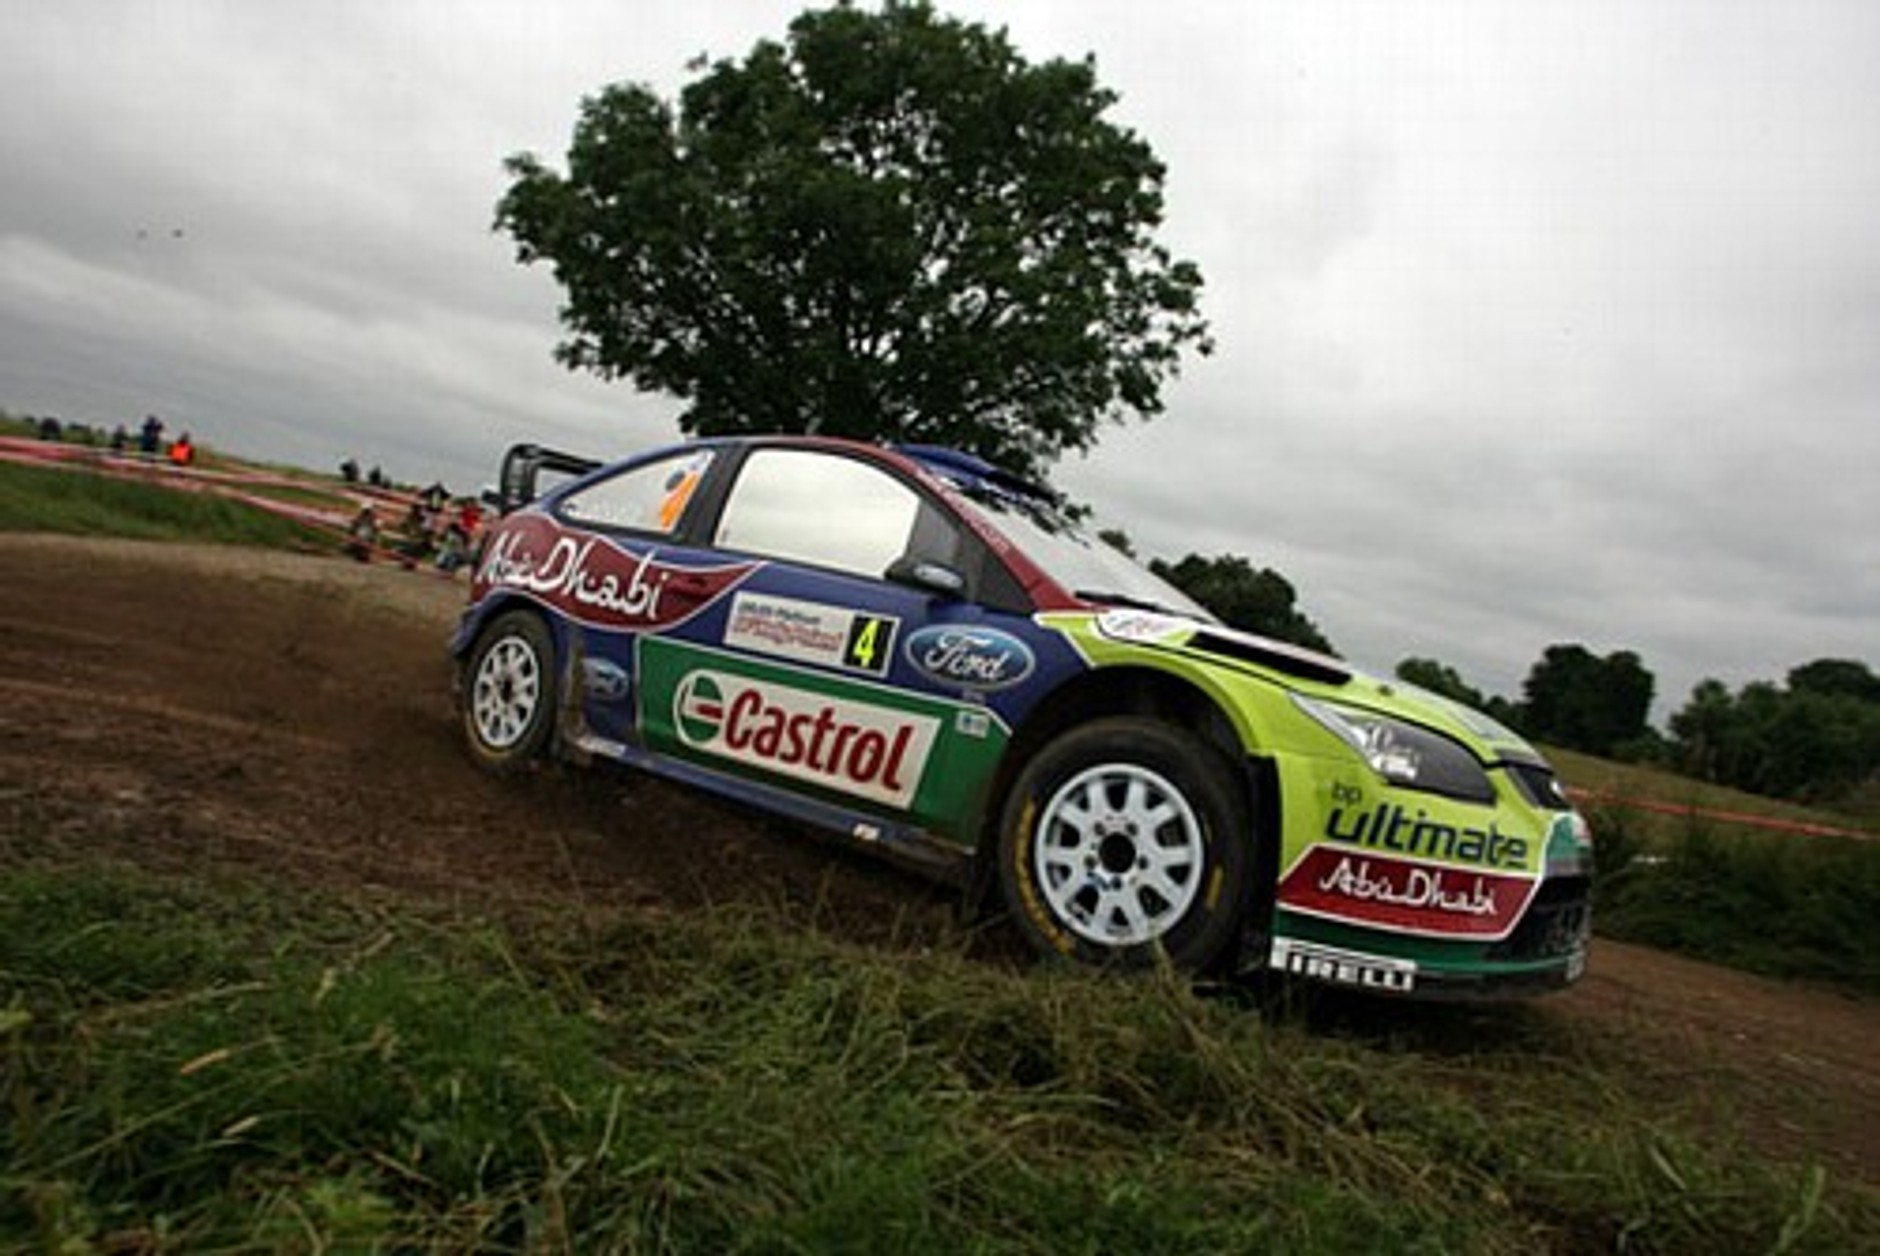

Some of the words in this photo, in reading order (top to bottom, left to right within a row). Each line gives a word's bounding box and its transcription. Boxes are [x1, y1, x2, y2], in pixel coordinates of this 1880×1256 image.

[853, 617, 881, 668] 4
[924, 632, 1012, 679] Ford
[724, 688, 915, 792] Castrol
[1332, 782, 1362, 806] bp
[1325, 802, 1528, 870] ultimate
[1270, 937, 1416, 991] PIRELLI
